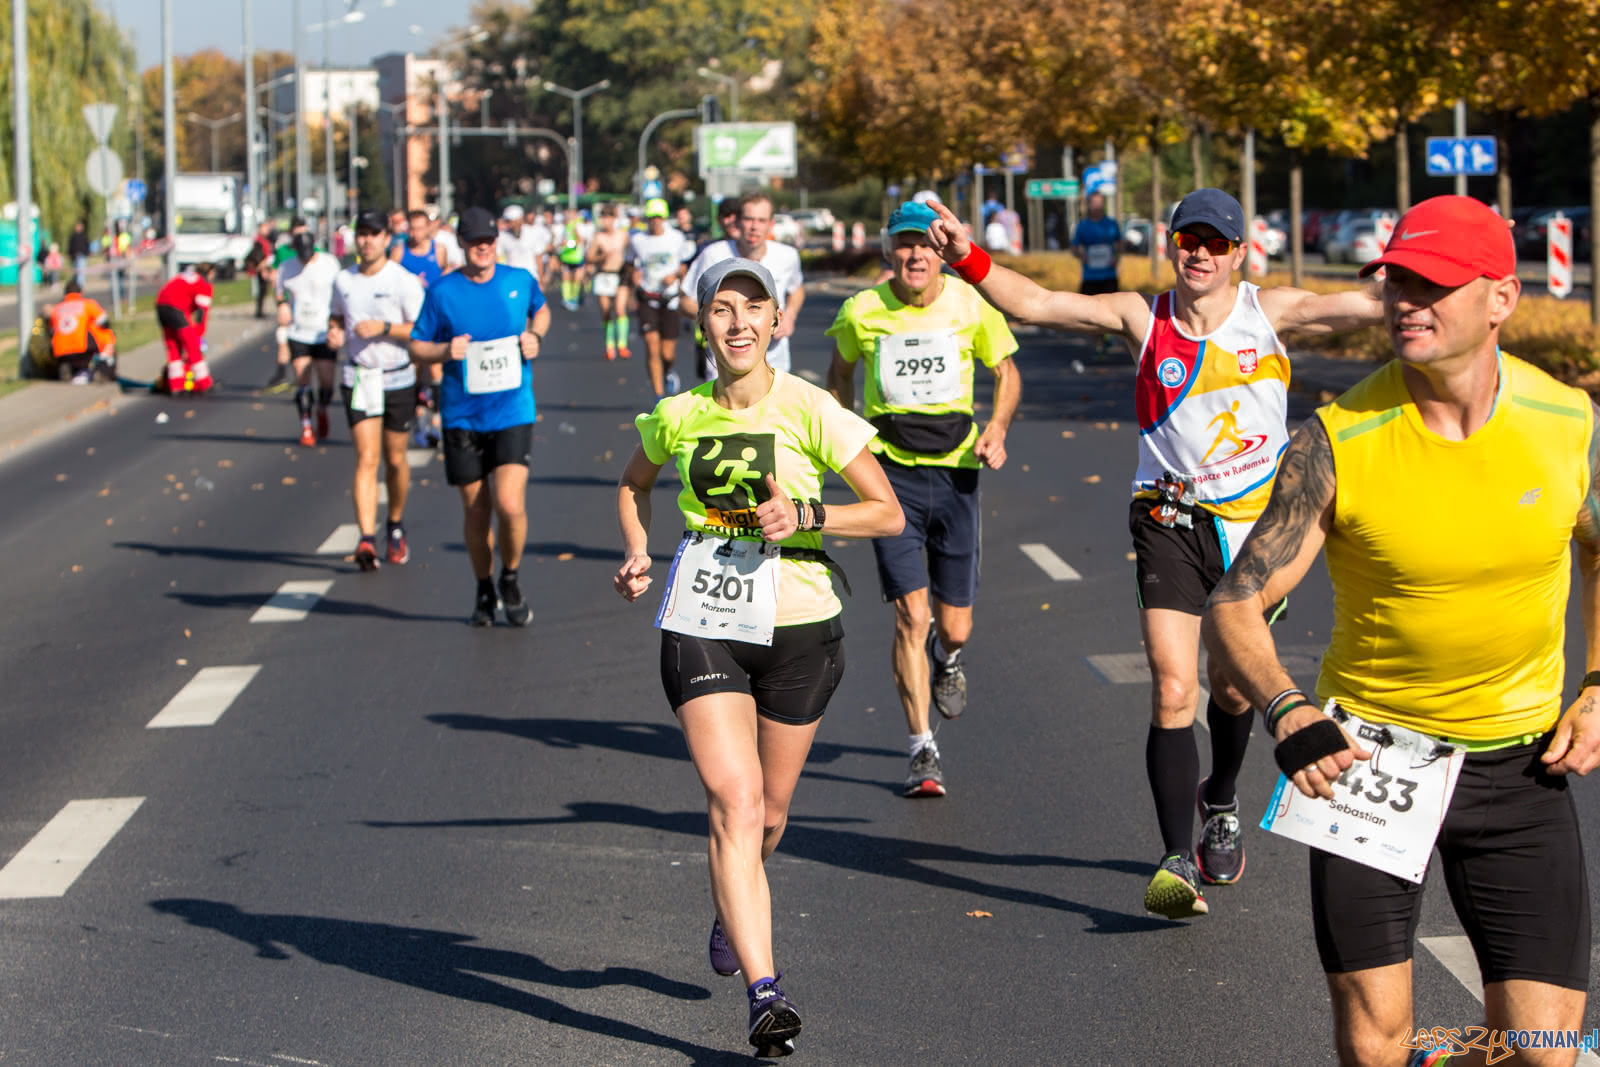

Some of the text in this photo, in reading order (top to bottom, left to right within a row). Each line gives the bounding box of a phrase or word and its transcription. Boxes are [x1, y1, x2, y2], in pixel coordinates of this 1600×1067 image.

[479, 355, 509, 371] 4151
[894, 356, 946, 377] 2993
[1223, 470, 1230, 478] w
[691, 568, 755, 603] 5201
[700, 601, 736, 614] Marzena
[690, 673, 721, 684] CRAFT
[1328, 799, 1387, 827] Sebastian
